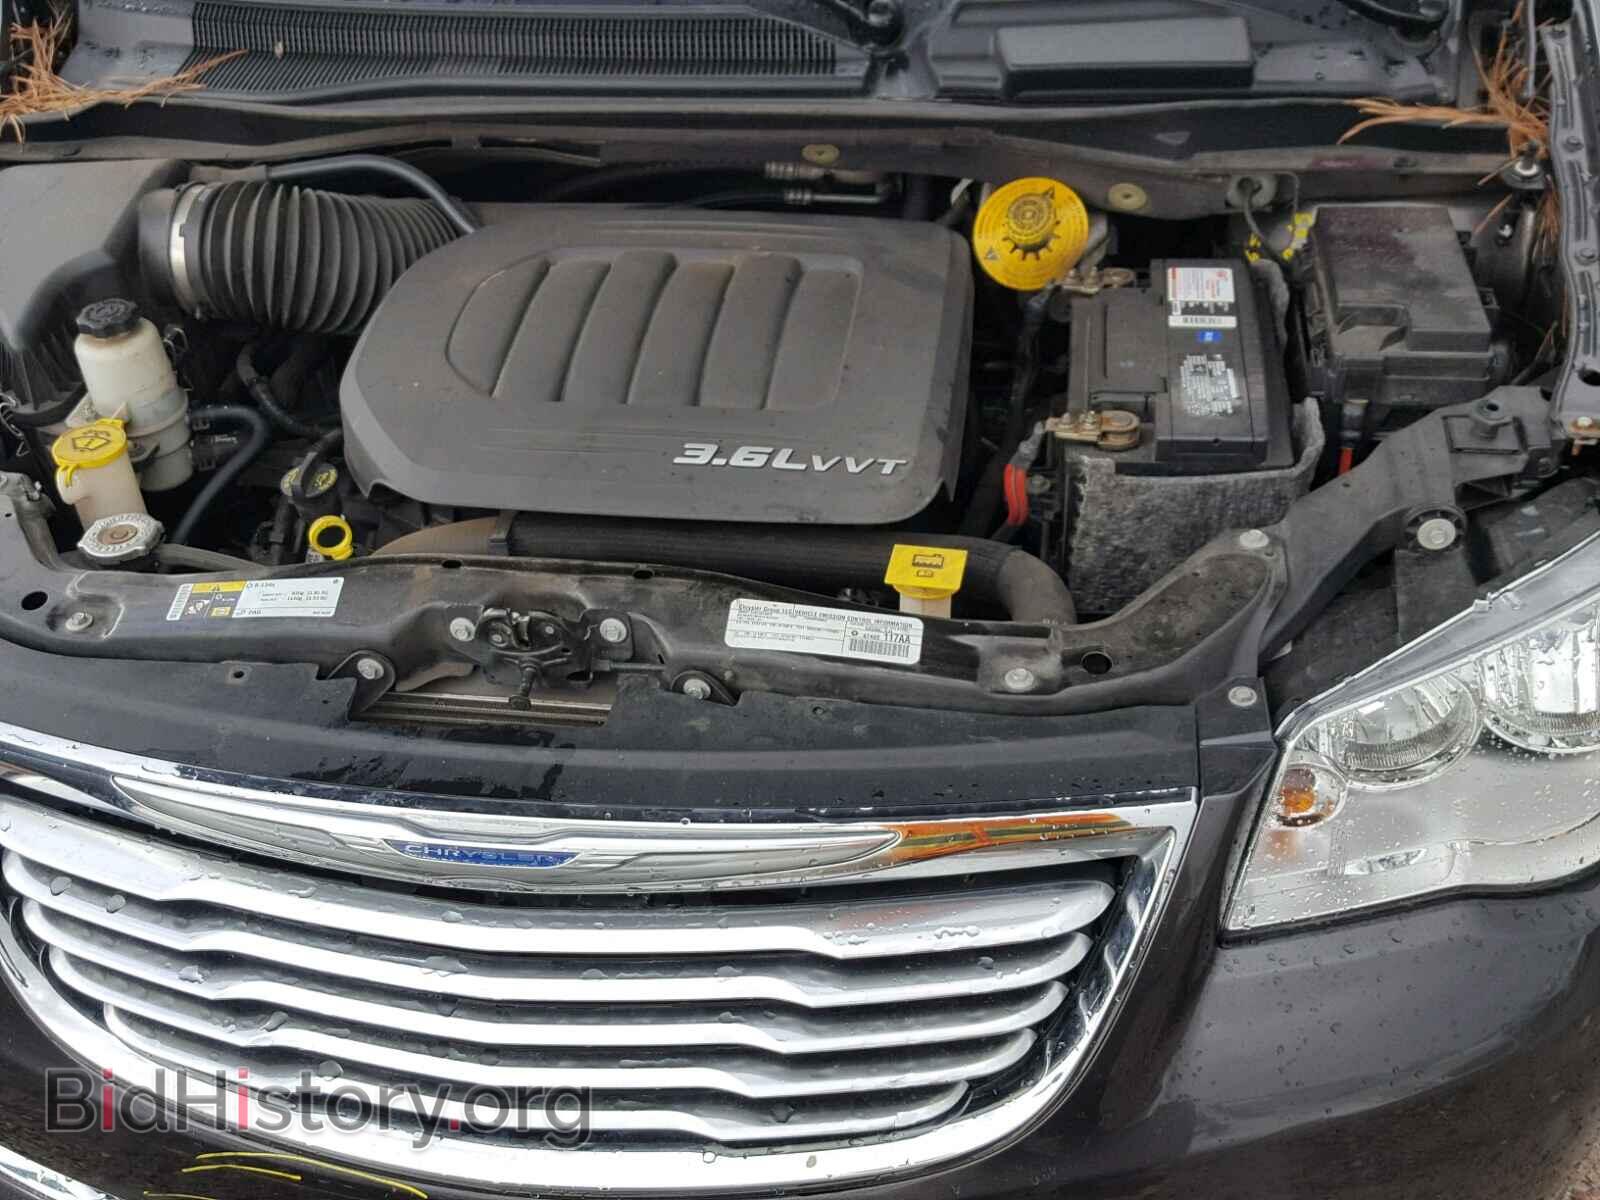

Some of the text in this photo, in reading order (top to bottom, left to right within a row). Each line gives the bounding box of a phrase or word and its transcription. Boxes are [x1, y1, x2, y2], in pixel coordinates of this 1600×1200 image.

[673, 443, 908, 475] 3.6L VVT
[404, 844, 558, 863] CHRYSLER
